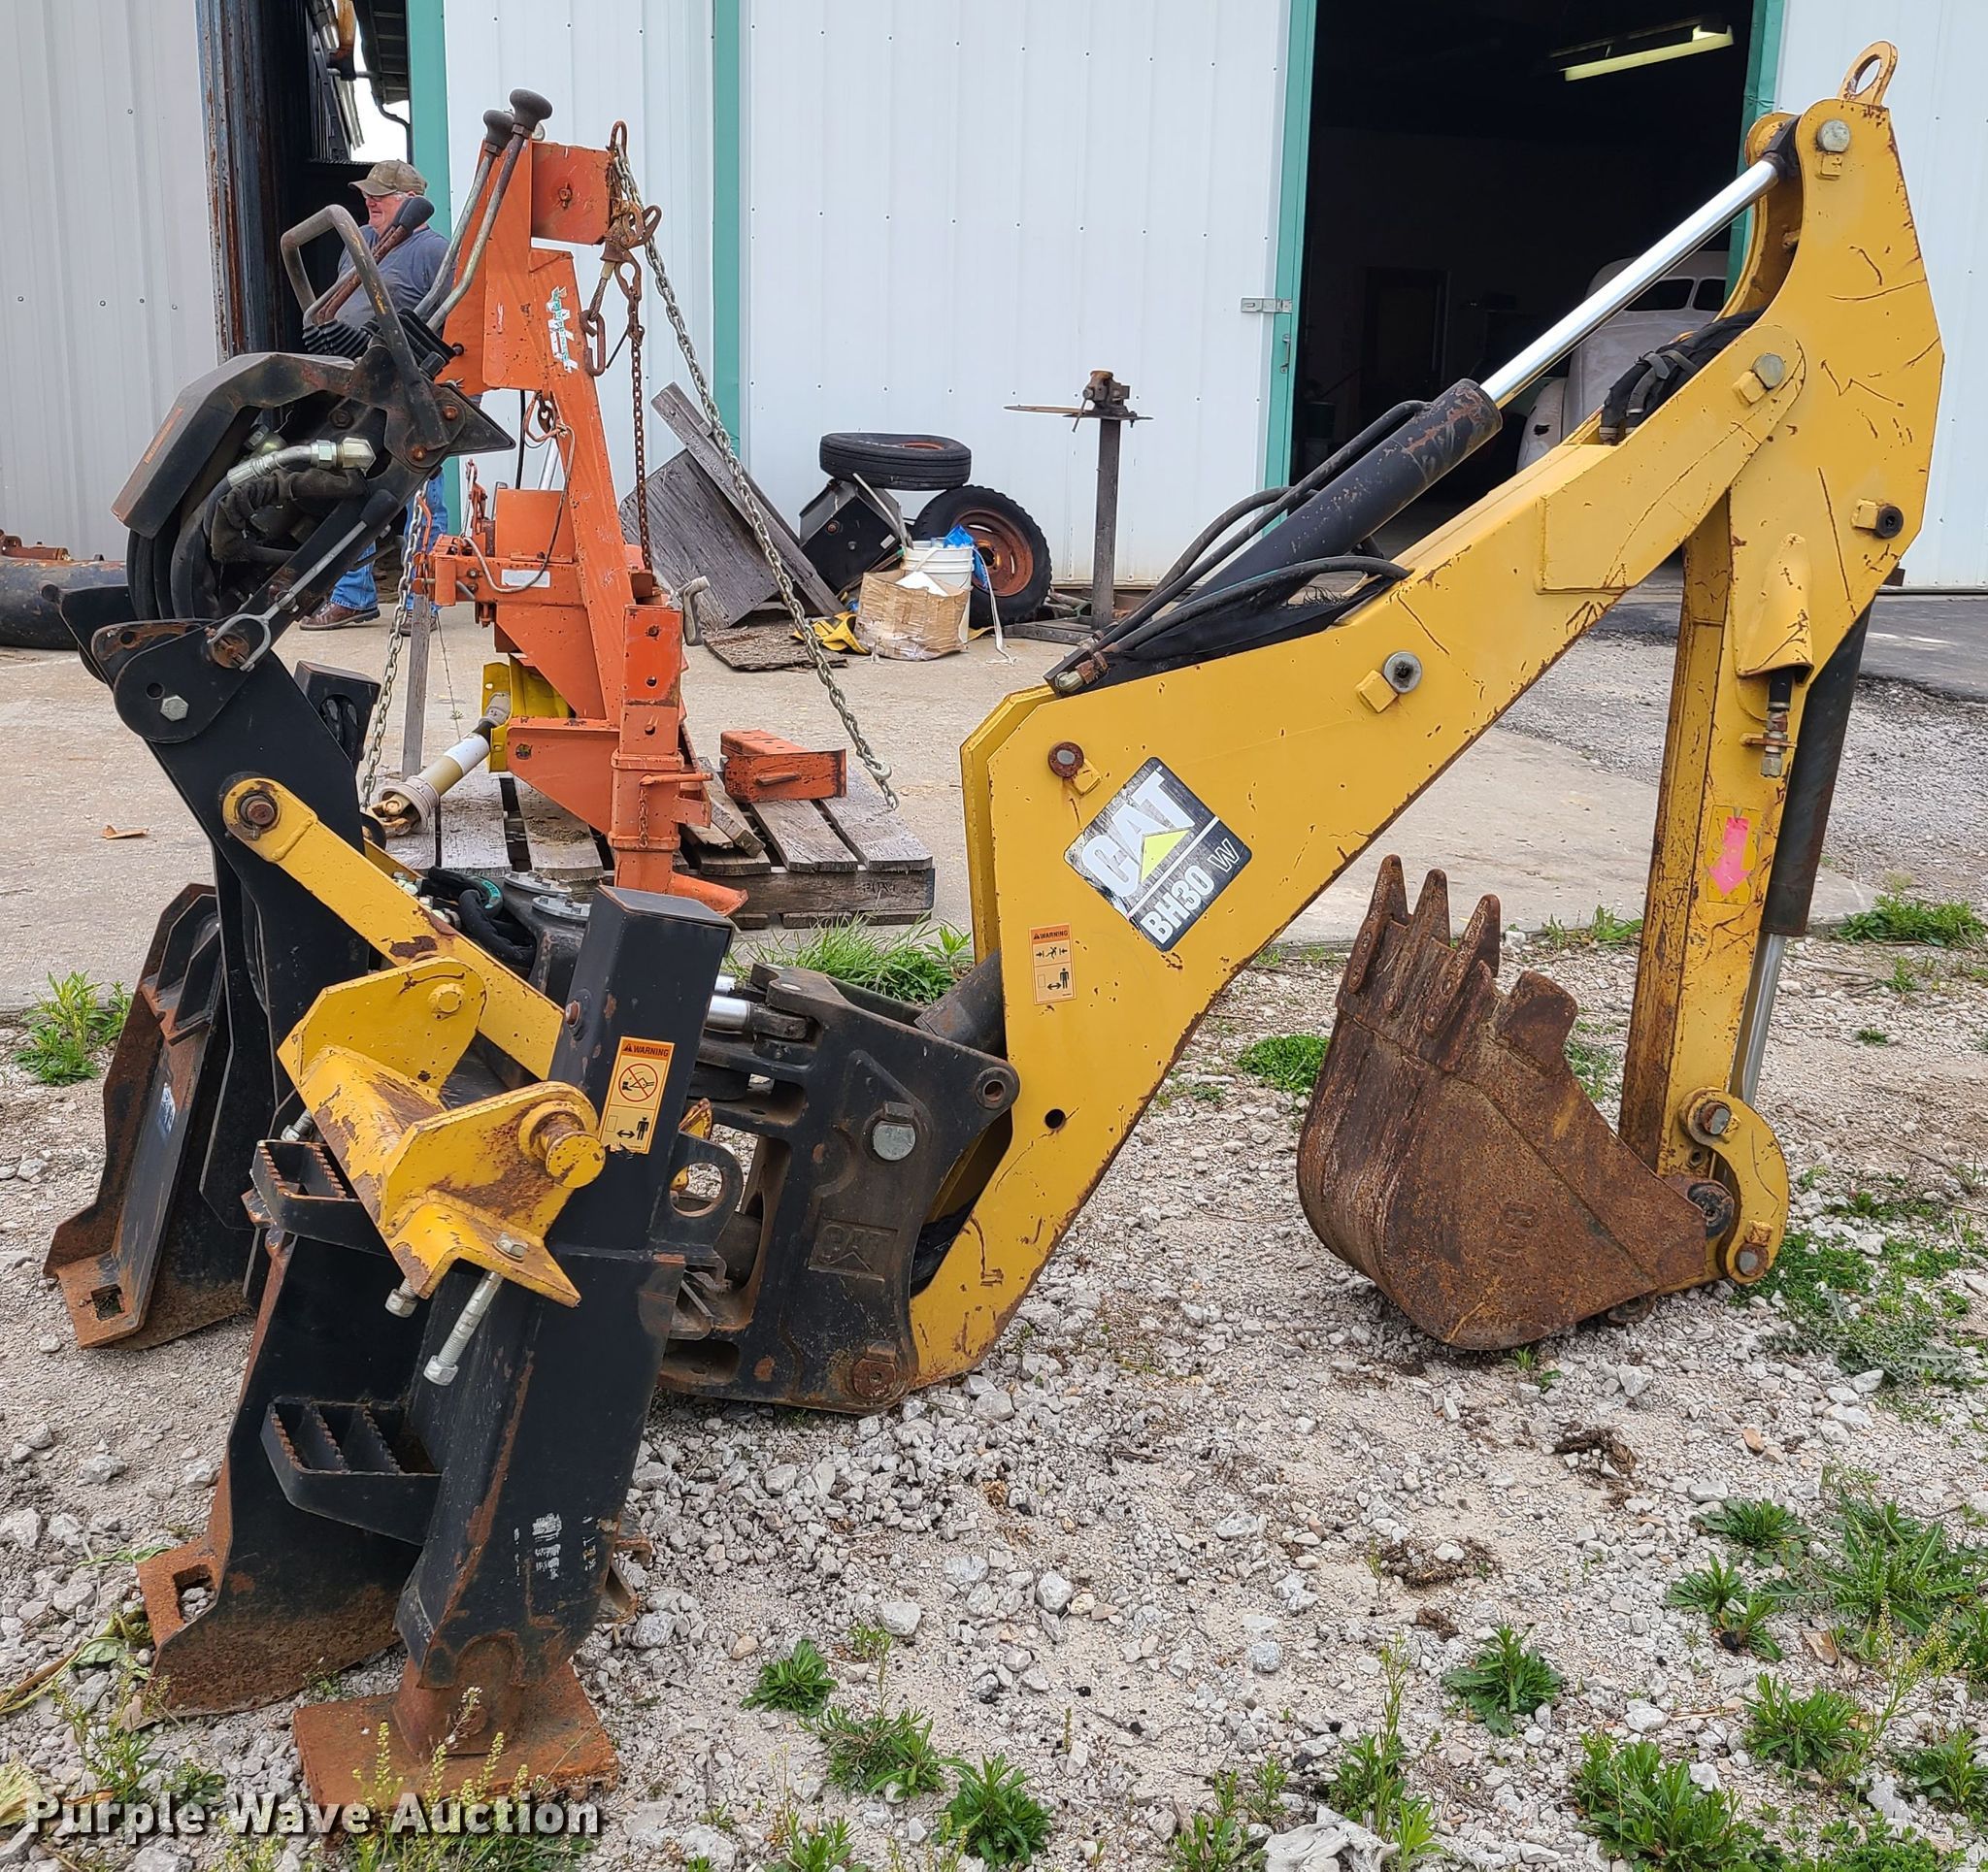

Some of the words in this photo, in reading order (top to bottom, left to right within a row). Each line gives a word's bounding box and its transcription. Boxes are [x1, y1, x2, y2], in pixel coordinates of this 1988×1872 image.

[1081, 770, 1196, 898] CAT
[1140, 865, 1215, 945] BH30
[1039, 930, 1069, 940] WARNING
[632, 1044, 669, 1057] WARNING
